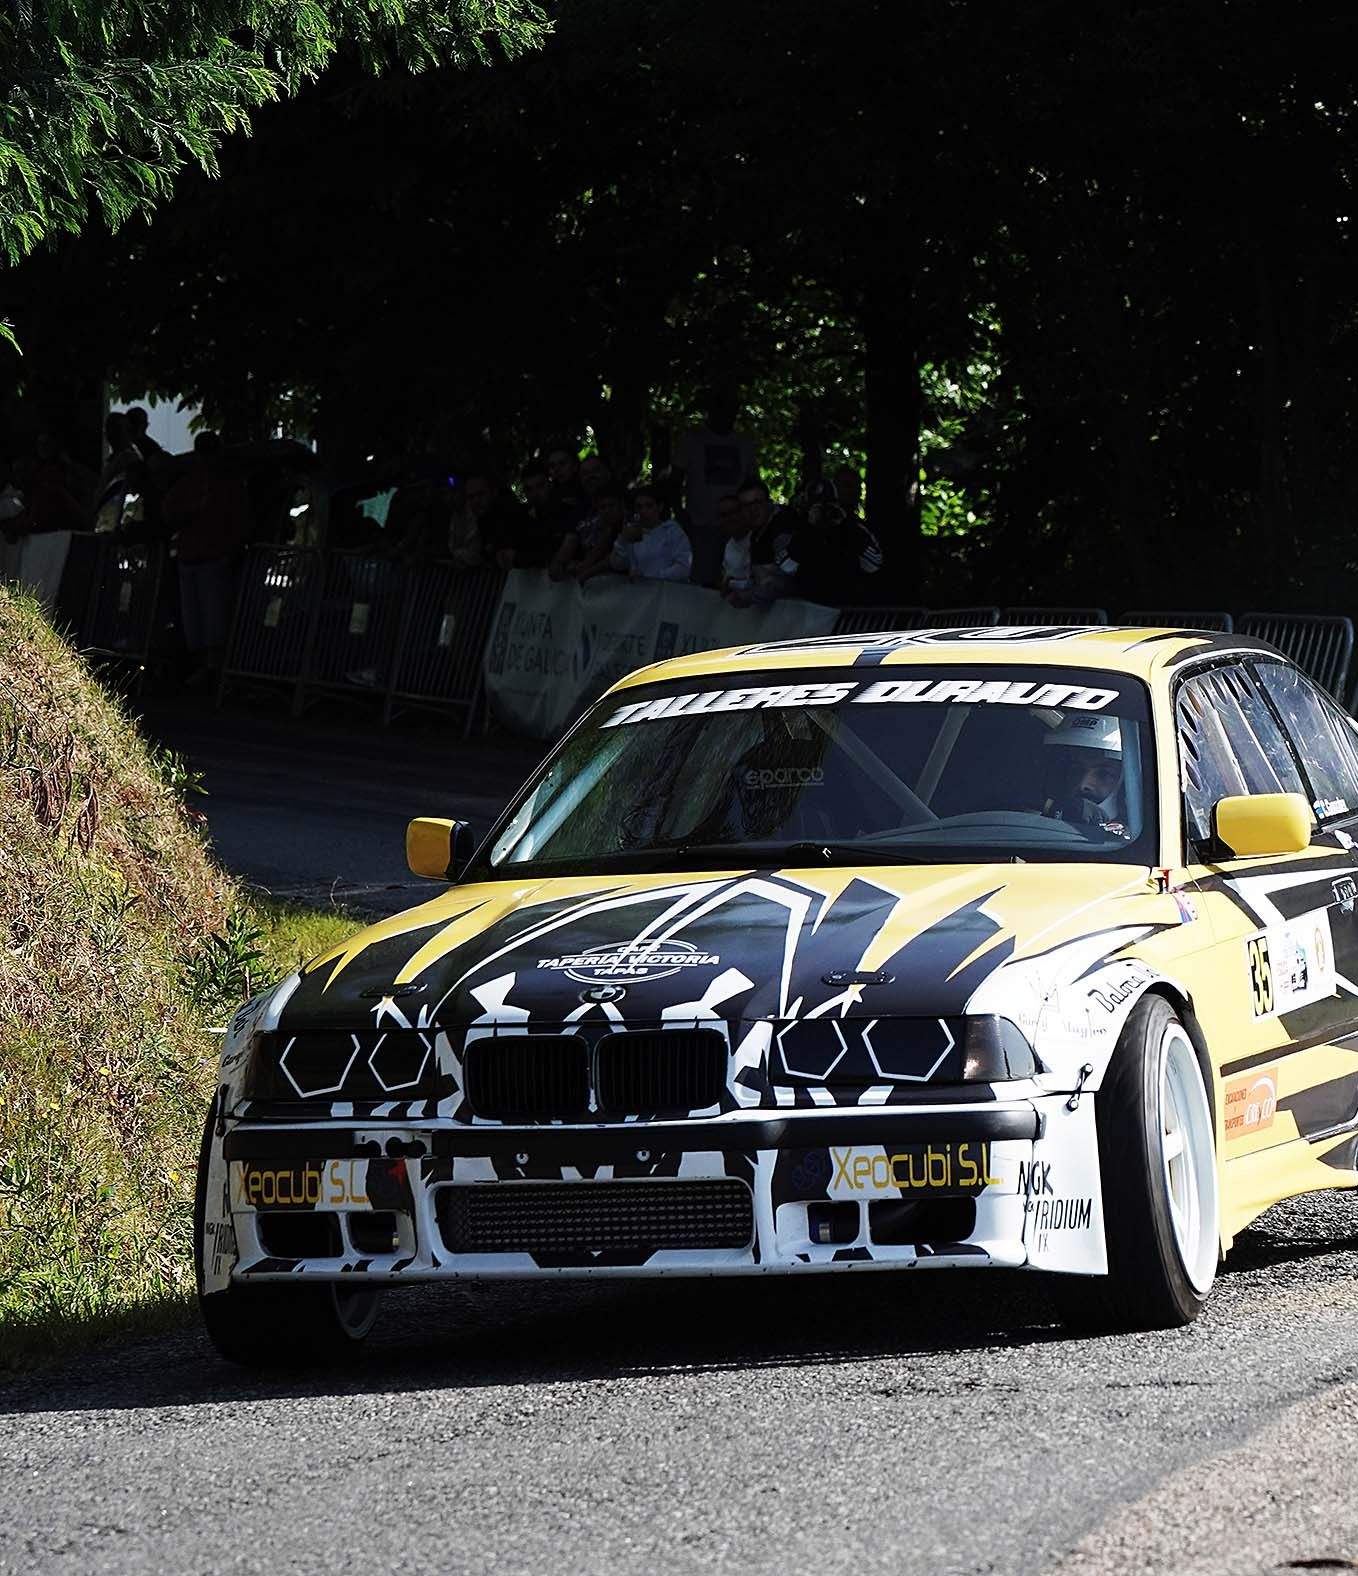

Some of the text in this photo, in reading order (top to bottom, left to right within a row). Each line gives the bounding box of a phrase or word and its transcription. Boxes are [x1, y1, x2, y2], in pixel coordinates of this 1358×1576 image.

[600, 680, 1119, 728] TALLERES DURAUTO
[628, 955, 720, 965] VICTORIA
[1247, 935, 1275, 1017] 35
[236, 1161, 325, 1205] Xeocubi
[833, 1144, 951, 1191] Xeocubi
[1016, 1160, 1054, 1196] NGK
